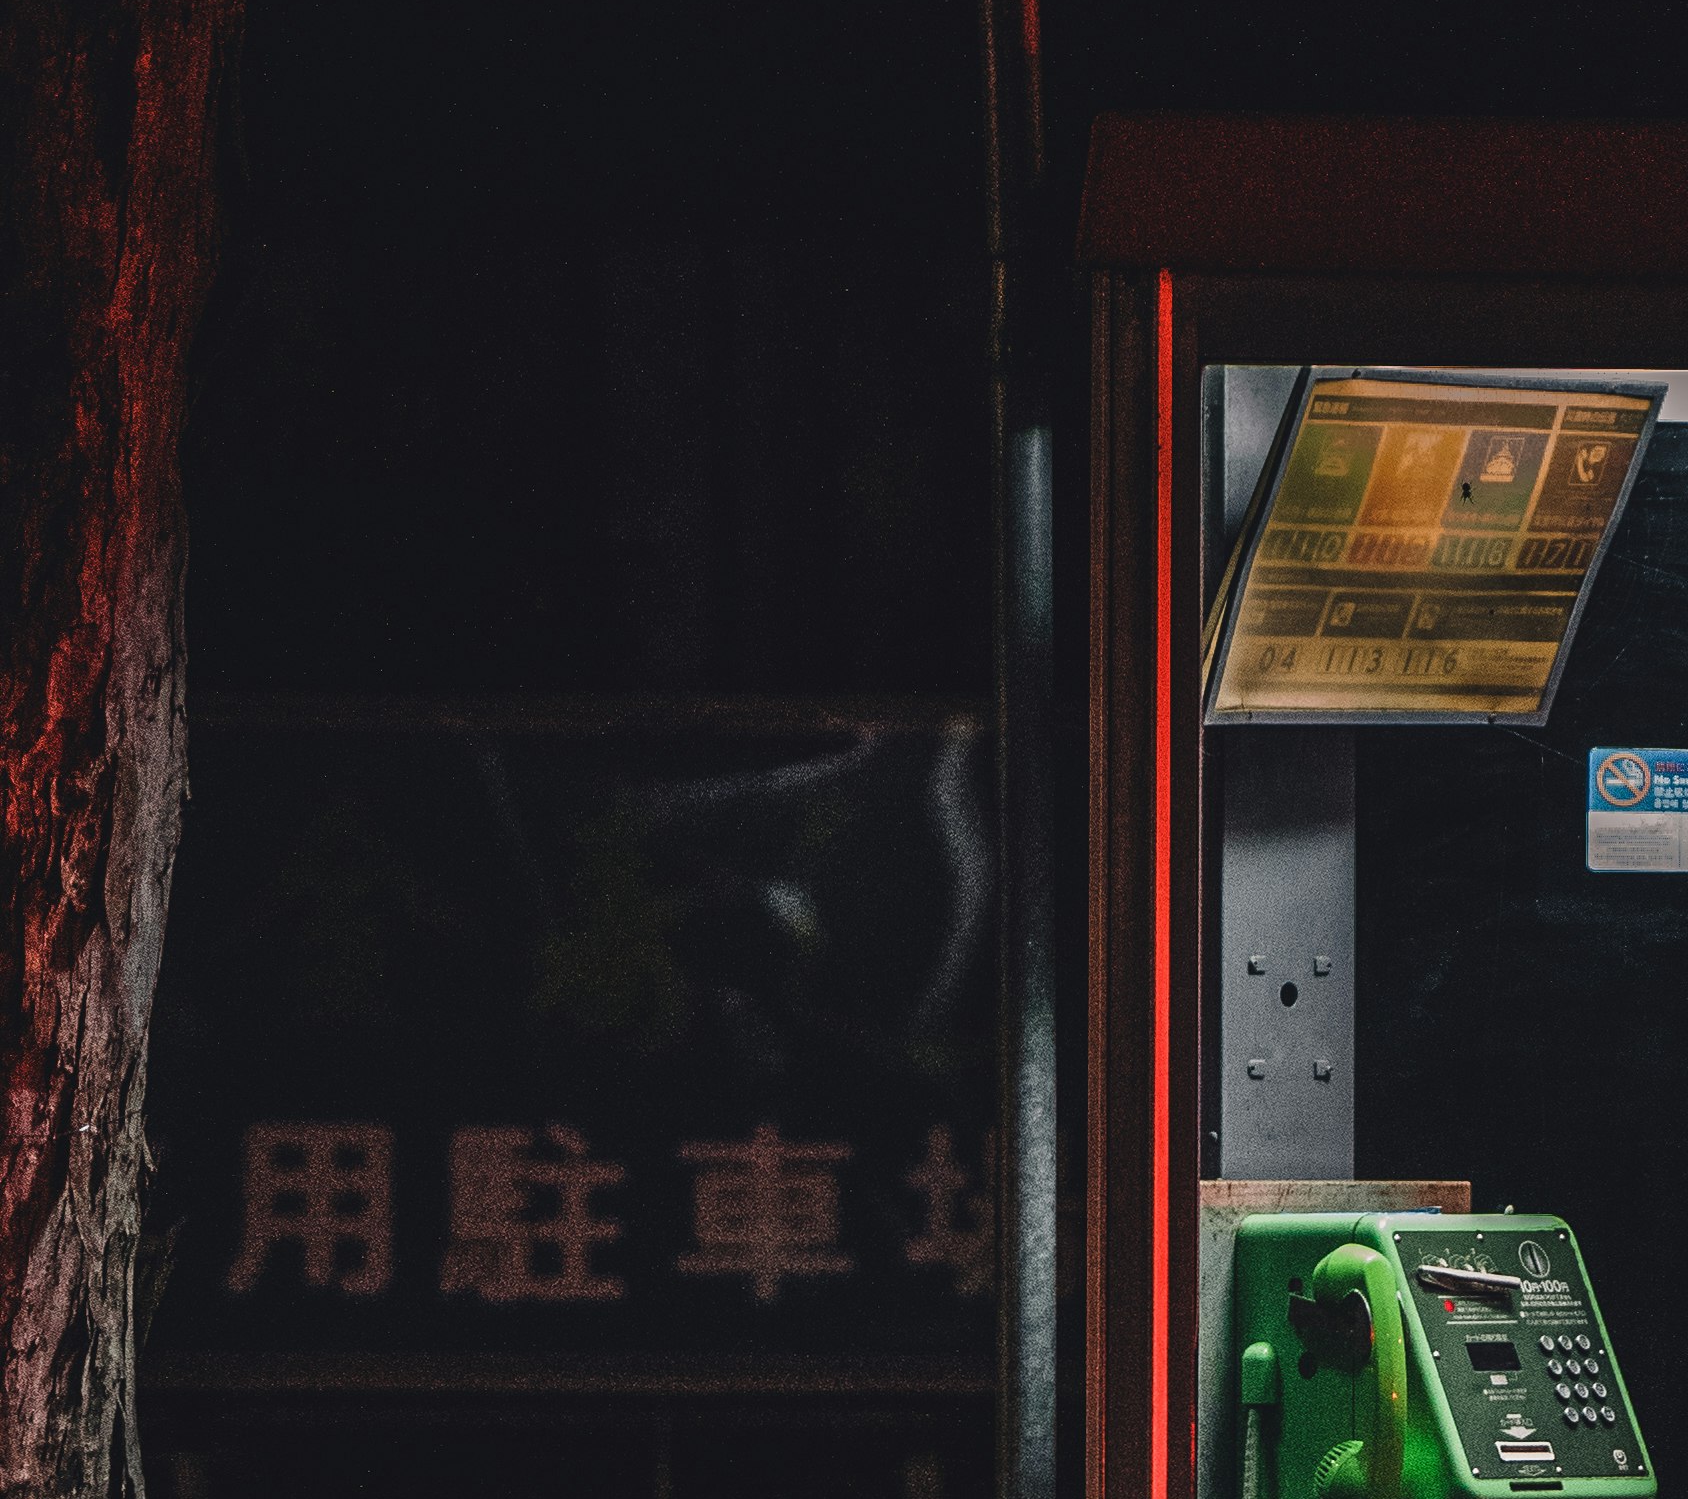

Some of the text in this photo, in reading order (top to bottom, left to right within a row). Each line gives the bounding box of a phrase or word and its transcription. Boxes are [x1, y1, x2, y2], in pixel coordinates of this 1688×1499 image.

[1523, 540, 1587, 567] 171
[1325, 647, 1384, 674] 113
[1402, 647, 1459, 675] 116
